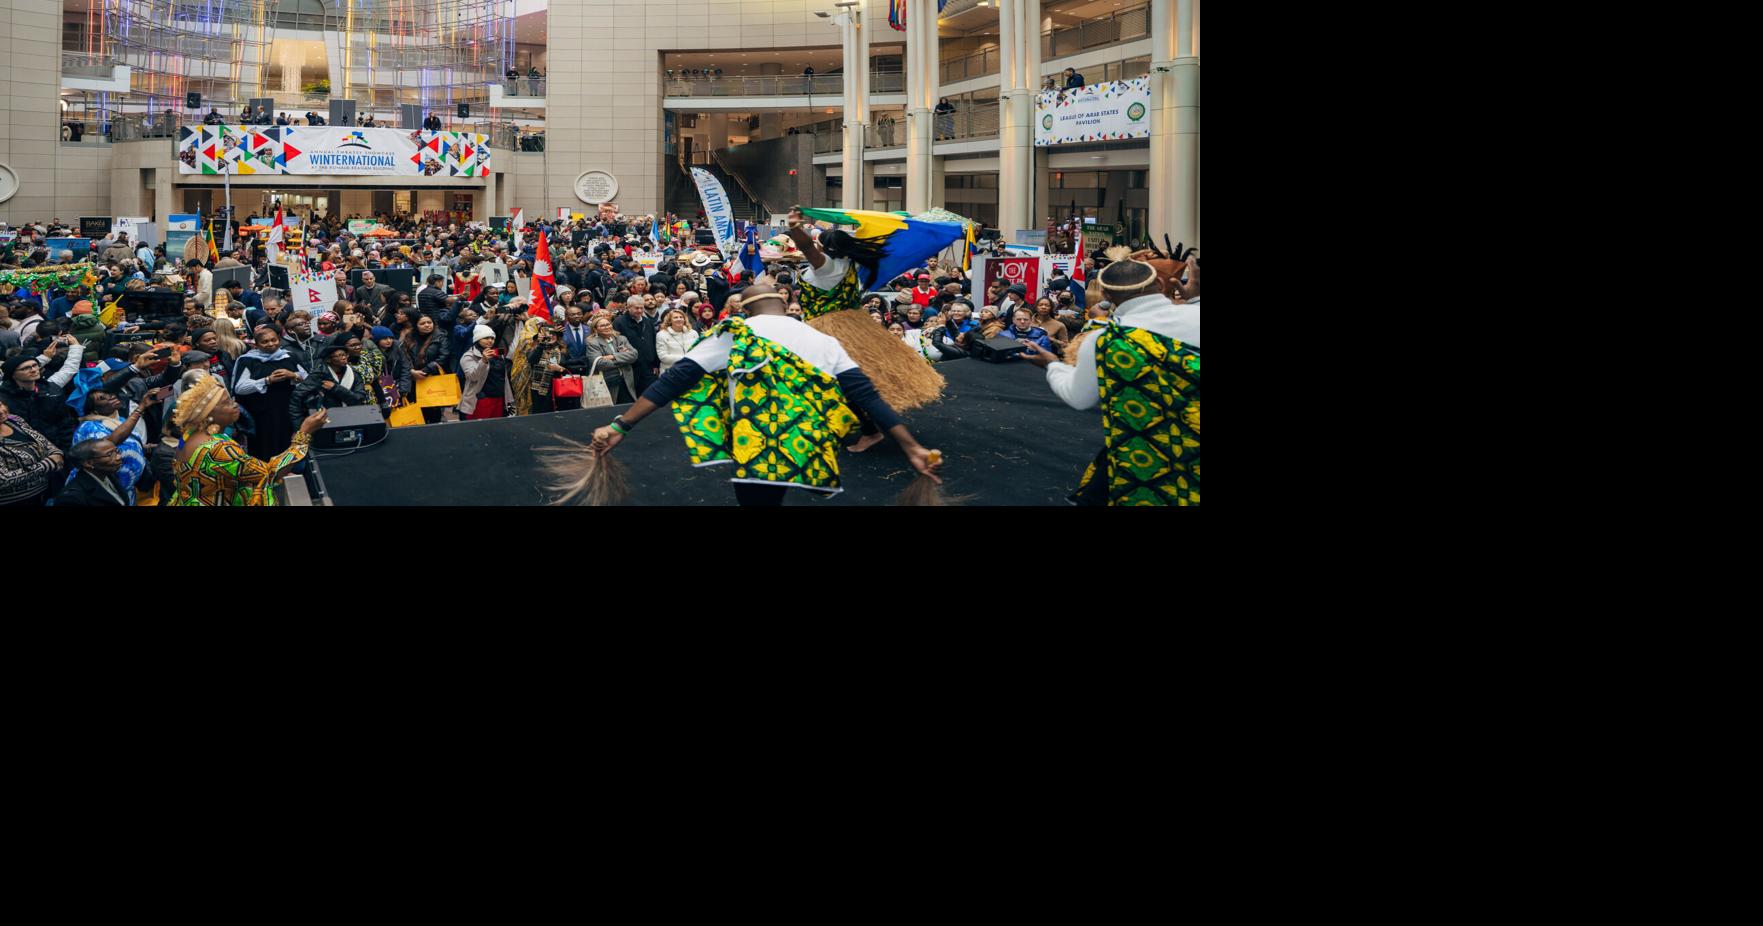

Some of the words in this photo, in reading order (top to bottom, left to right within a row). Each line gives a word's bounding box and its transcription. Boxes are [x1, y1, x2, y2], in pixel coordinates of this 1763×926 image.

[309, 154, 396, 167] WINTERNATIONAL
[704, 187, 724, 213] LATIN
[996, 262, 1028, 279] JOY
[1008, 266, 1016, 274] THE
